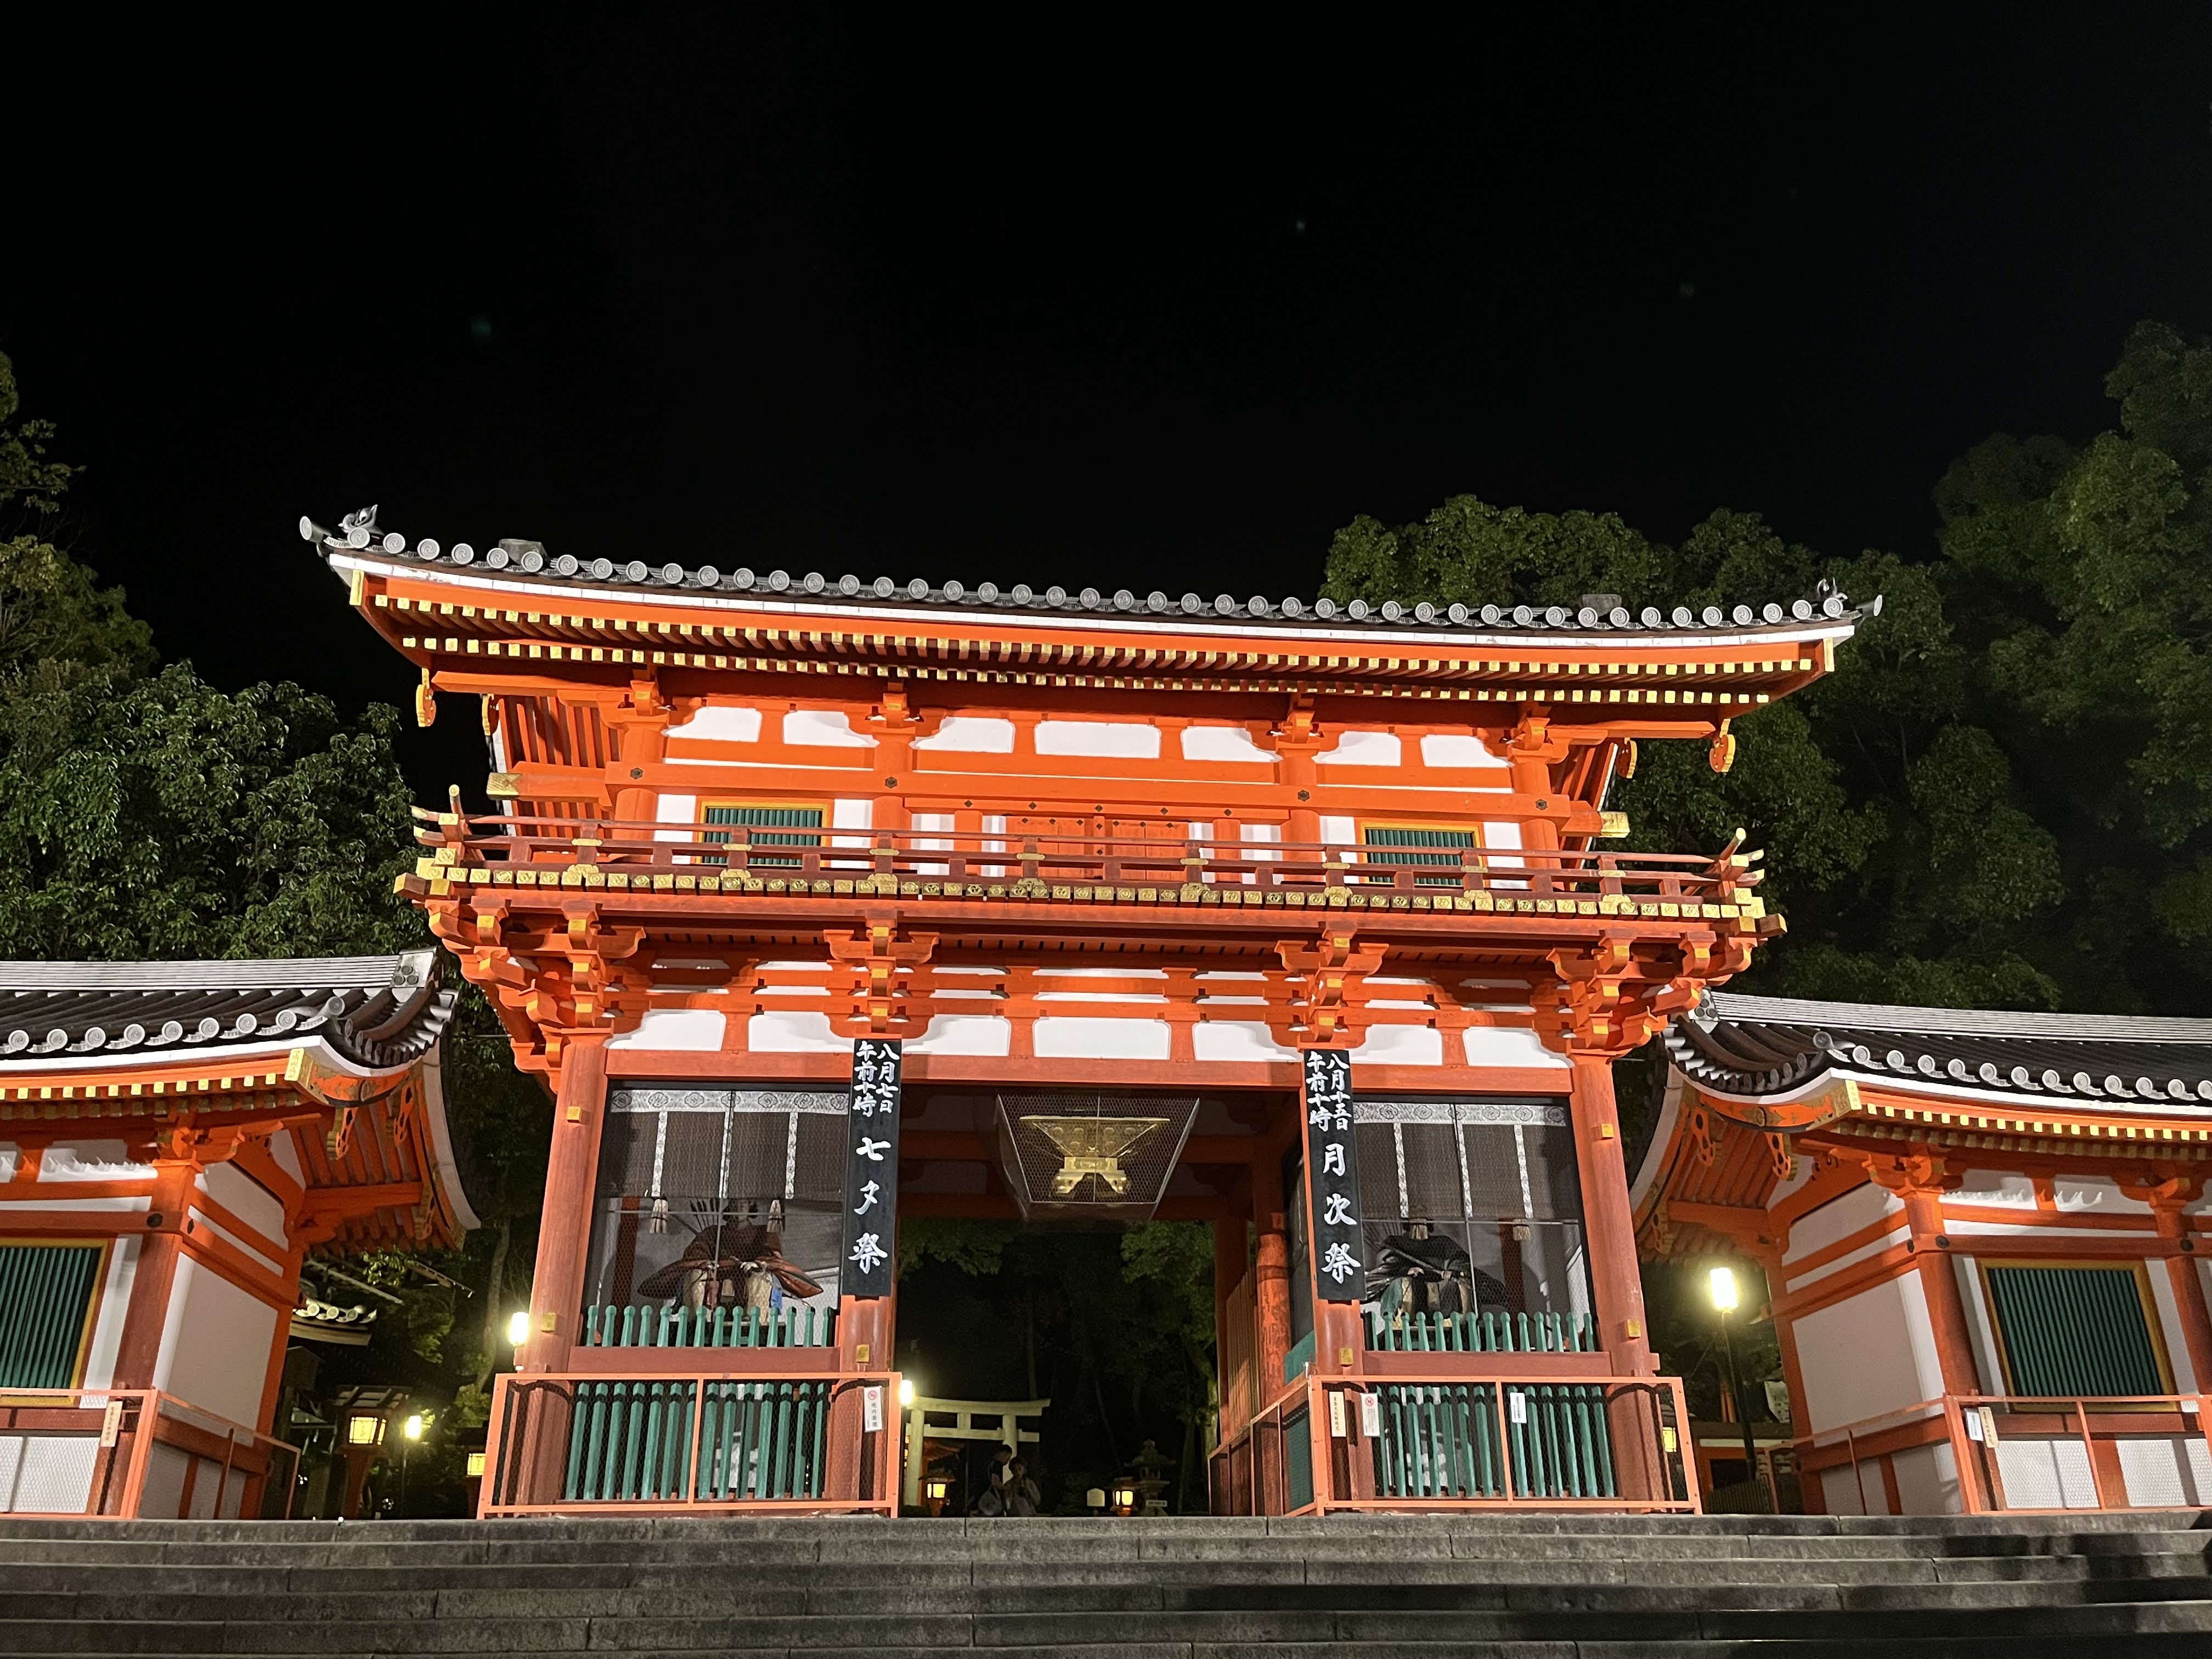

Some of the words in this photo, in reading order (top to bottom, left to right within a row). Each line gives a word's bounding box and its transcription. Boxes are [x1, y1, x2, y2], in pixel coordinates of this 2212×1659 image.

[852, 1040, 878, 1118] 午前十時
[876, 1043, 900, 1114] 八月七日
[1306, 1051, 1333, 1132] 午前十時
[1327, 1053, 1352, 1131] 八月十五日
[848, 1137, 891, 1274] 七夕祭
[1321, 1143, 1361, 1284] 月次祭
